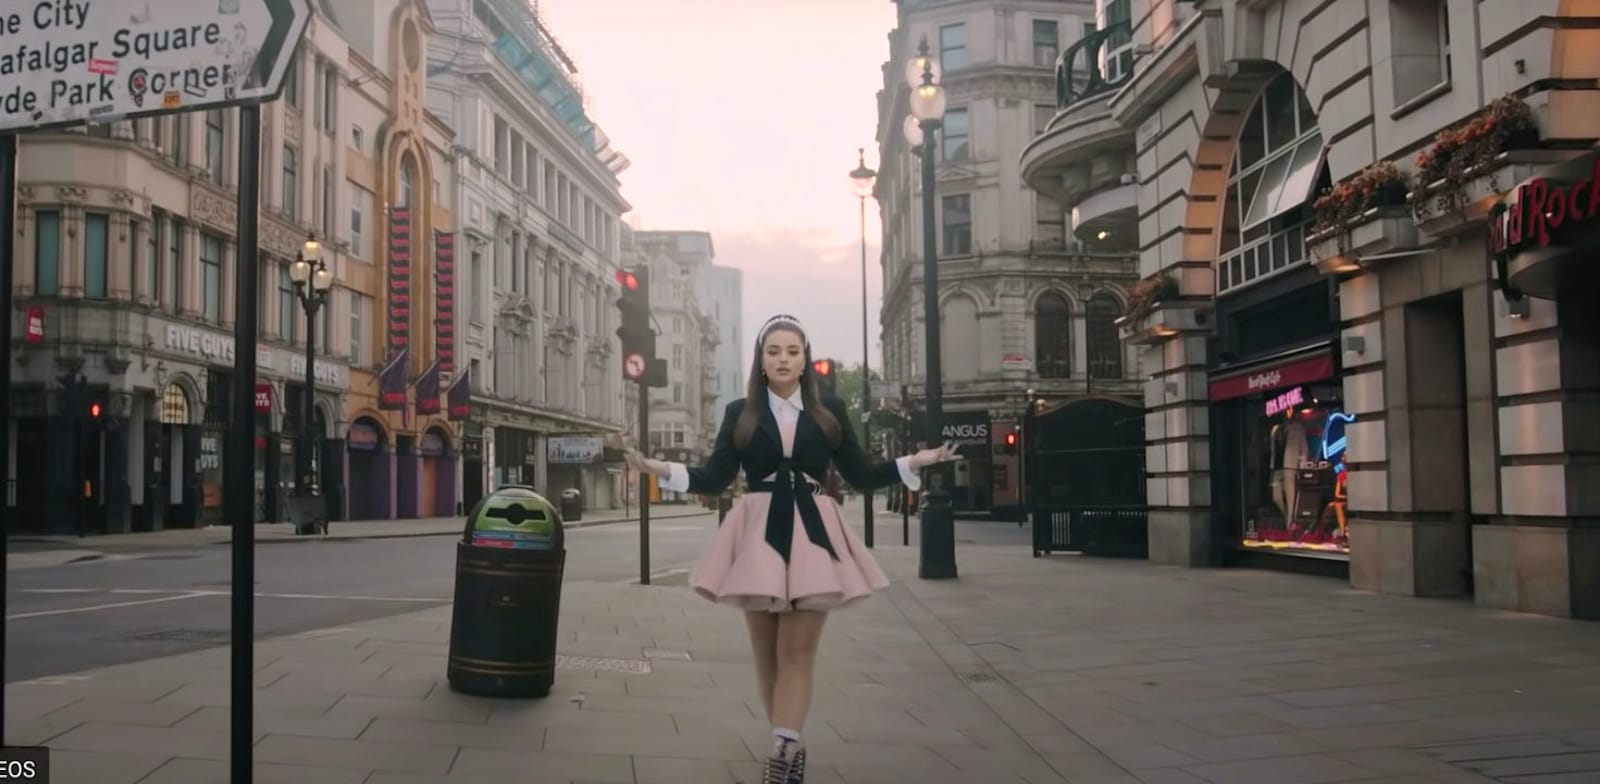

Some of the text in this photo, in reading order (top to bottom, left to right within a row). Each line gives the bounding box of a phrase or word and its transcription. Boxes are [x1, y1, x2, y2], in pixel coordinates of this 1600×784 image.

[34, 0, 89, 30] City
[112, 23, 220, 59] Square
[0, 86, 37, 114] de
[50, 73, 114, 108] Park
[128, 65, 231, 97] Corner
[166, 325, 201, 352] FIVE
[201, 333, 235, 360] GUYS
[942, 424, 988, 438] ANGUS
